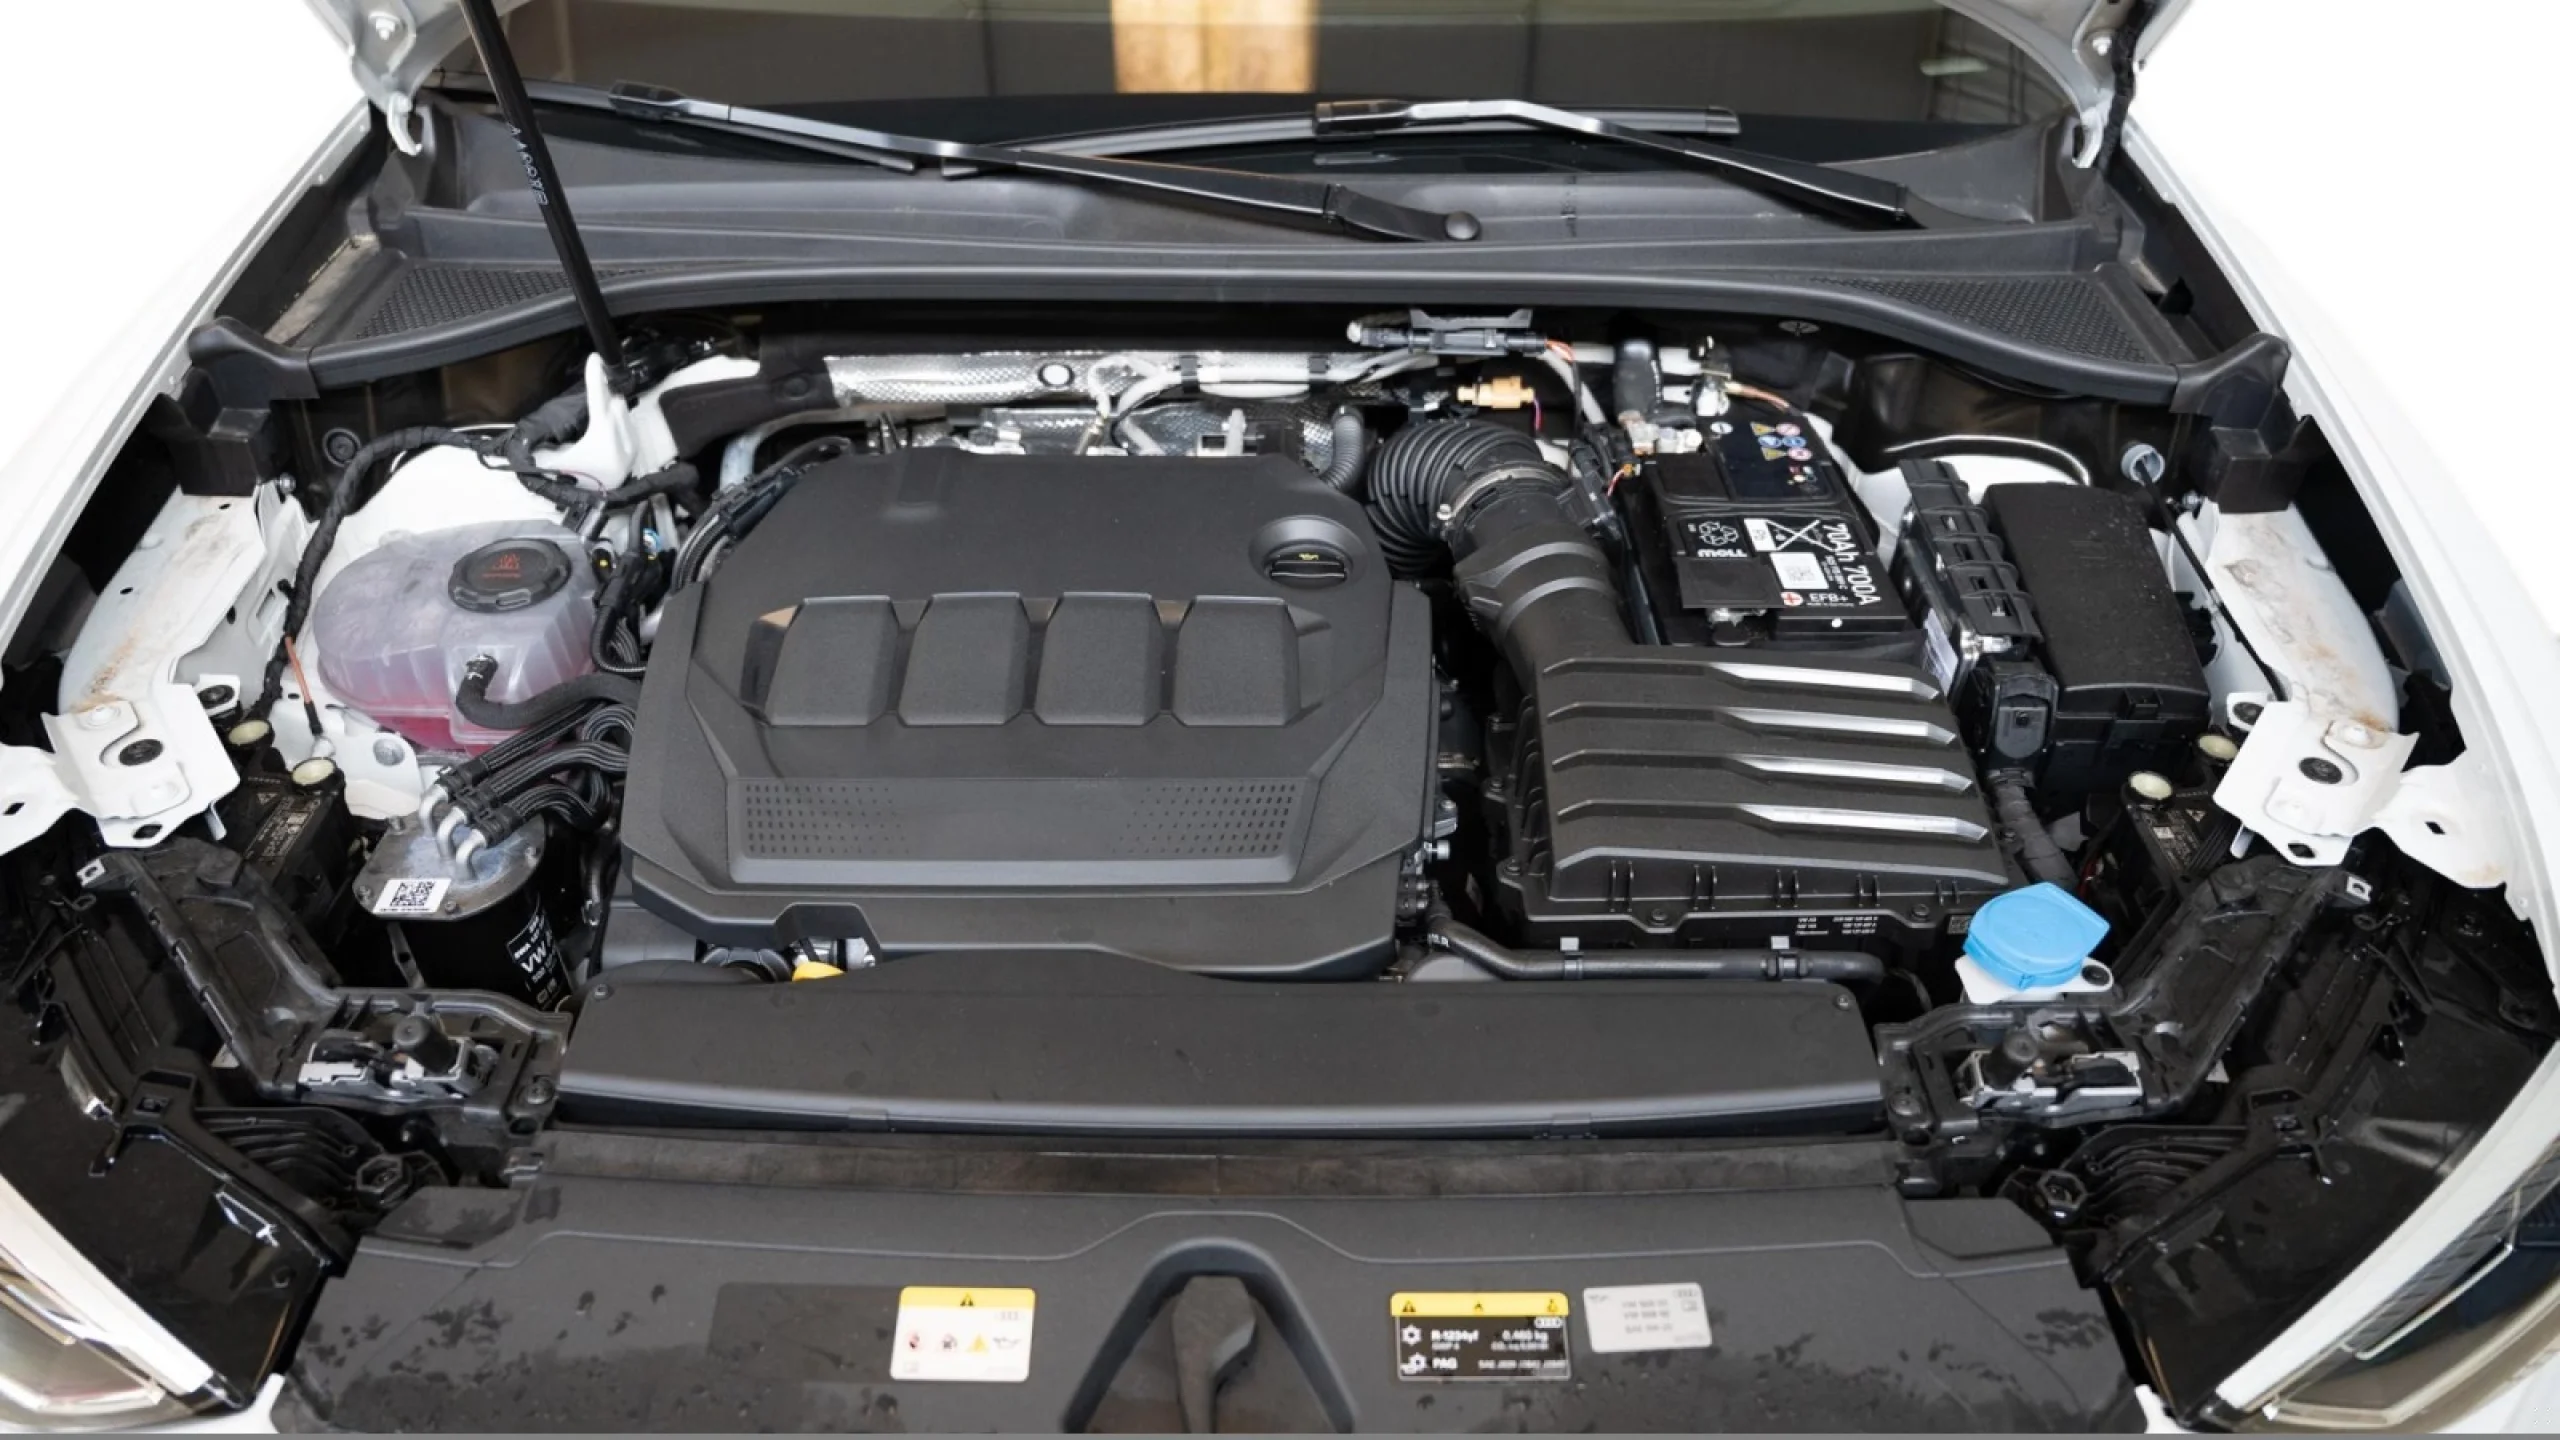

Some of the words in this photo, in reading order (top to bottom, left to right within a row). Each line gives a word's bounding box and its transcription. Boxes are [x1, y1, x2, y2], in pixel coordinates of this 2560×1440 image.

[1822, 522, 1860, 562] 70Ah
[1842, 564, 1881, 606] 700A
[1432, 1357, 1458, 1369] PAG
